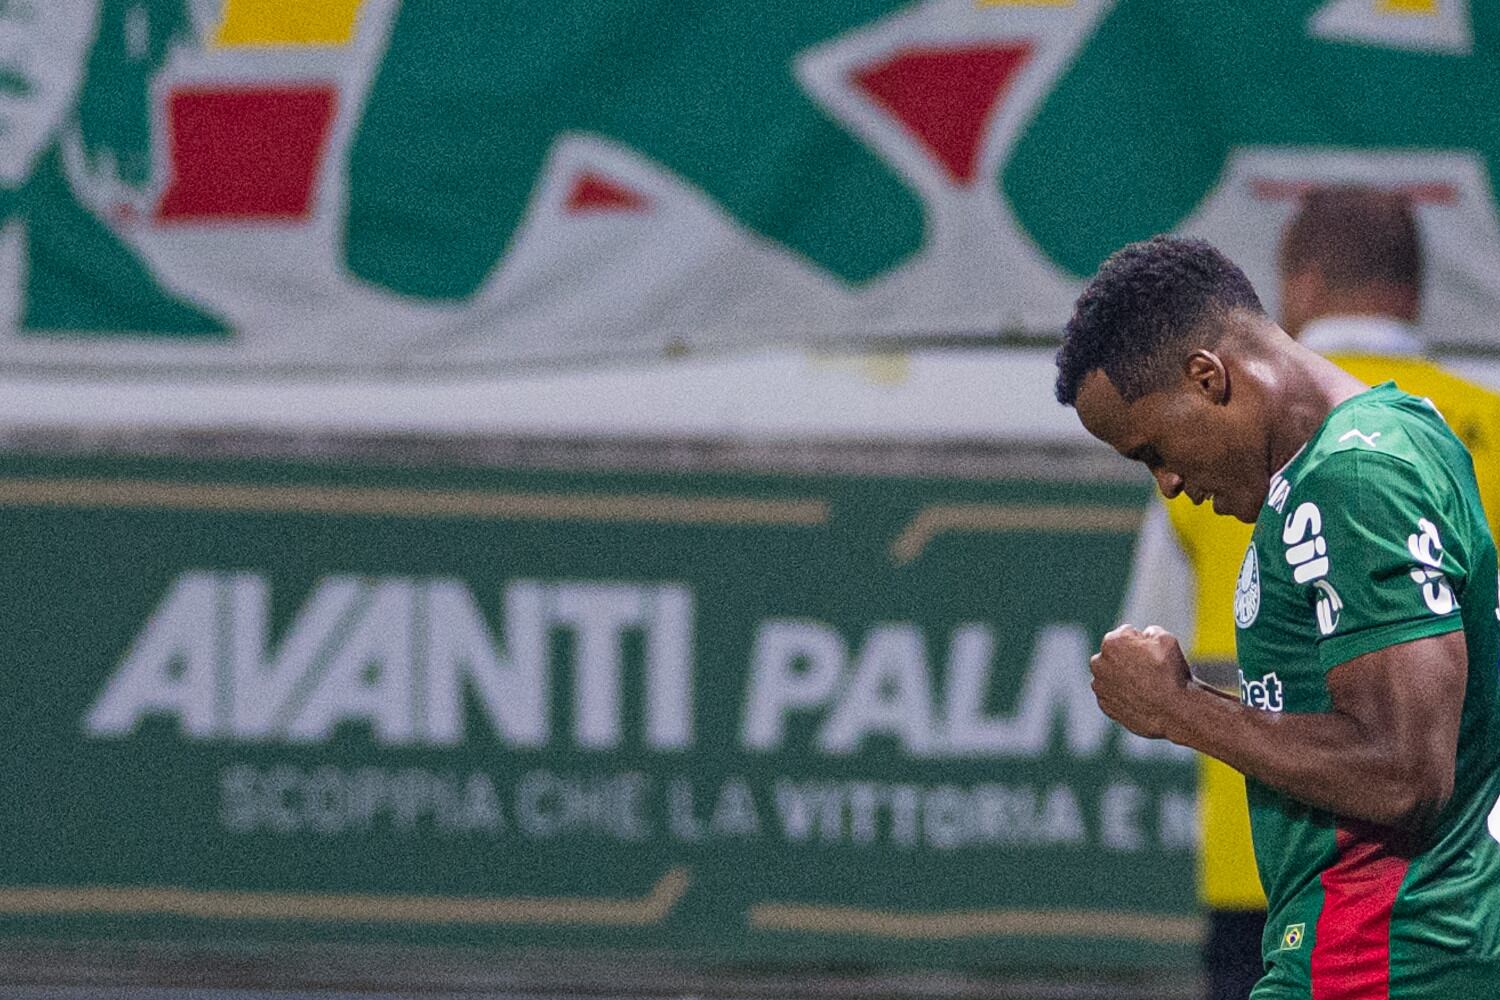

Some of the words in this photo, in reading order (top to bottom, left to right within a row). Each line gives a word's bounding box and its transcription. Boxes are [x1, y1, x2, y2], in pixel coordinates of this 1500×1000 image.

[84, 570, 694, 750] AVANTI
[218, 765, 505, 836] SCOPPIA
[518, 769, 650, 838] CHE
[668, 776, 762, 841] LA
[774, 780, 1088, 846] VITTORIA
